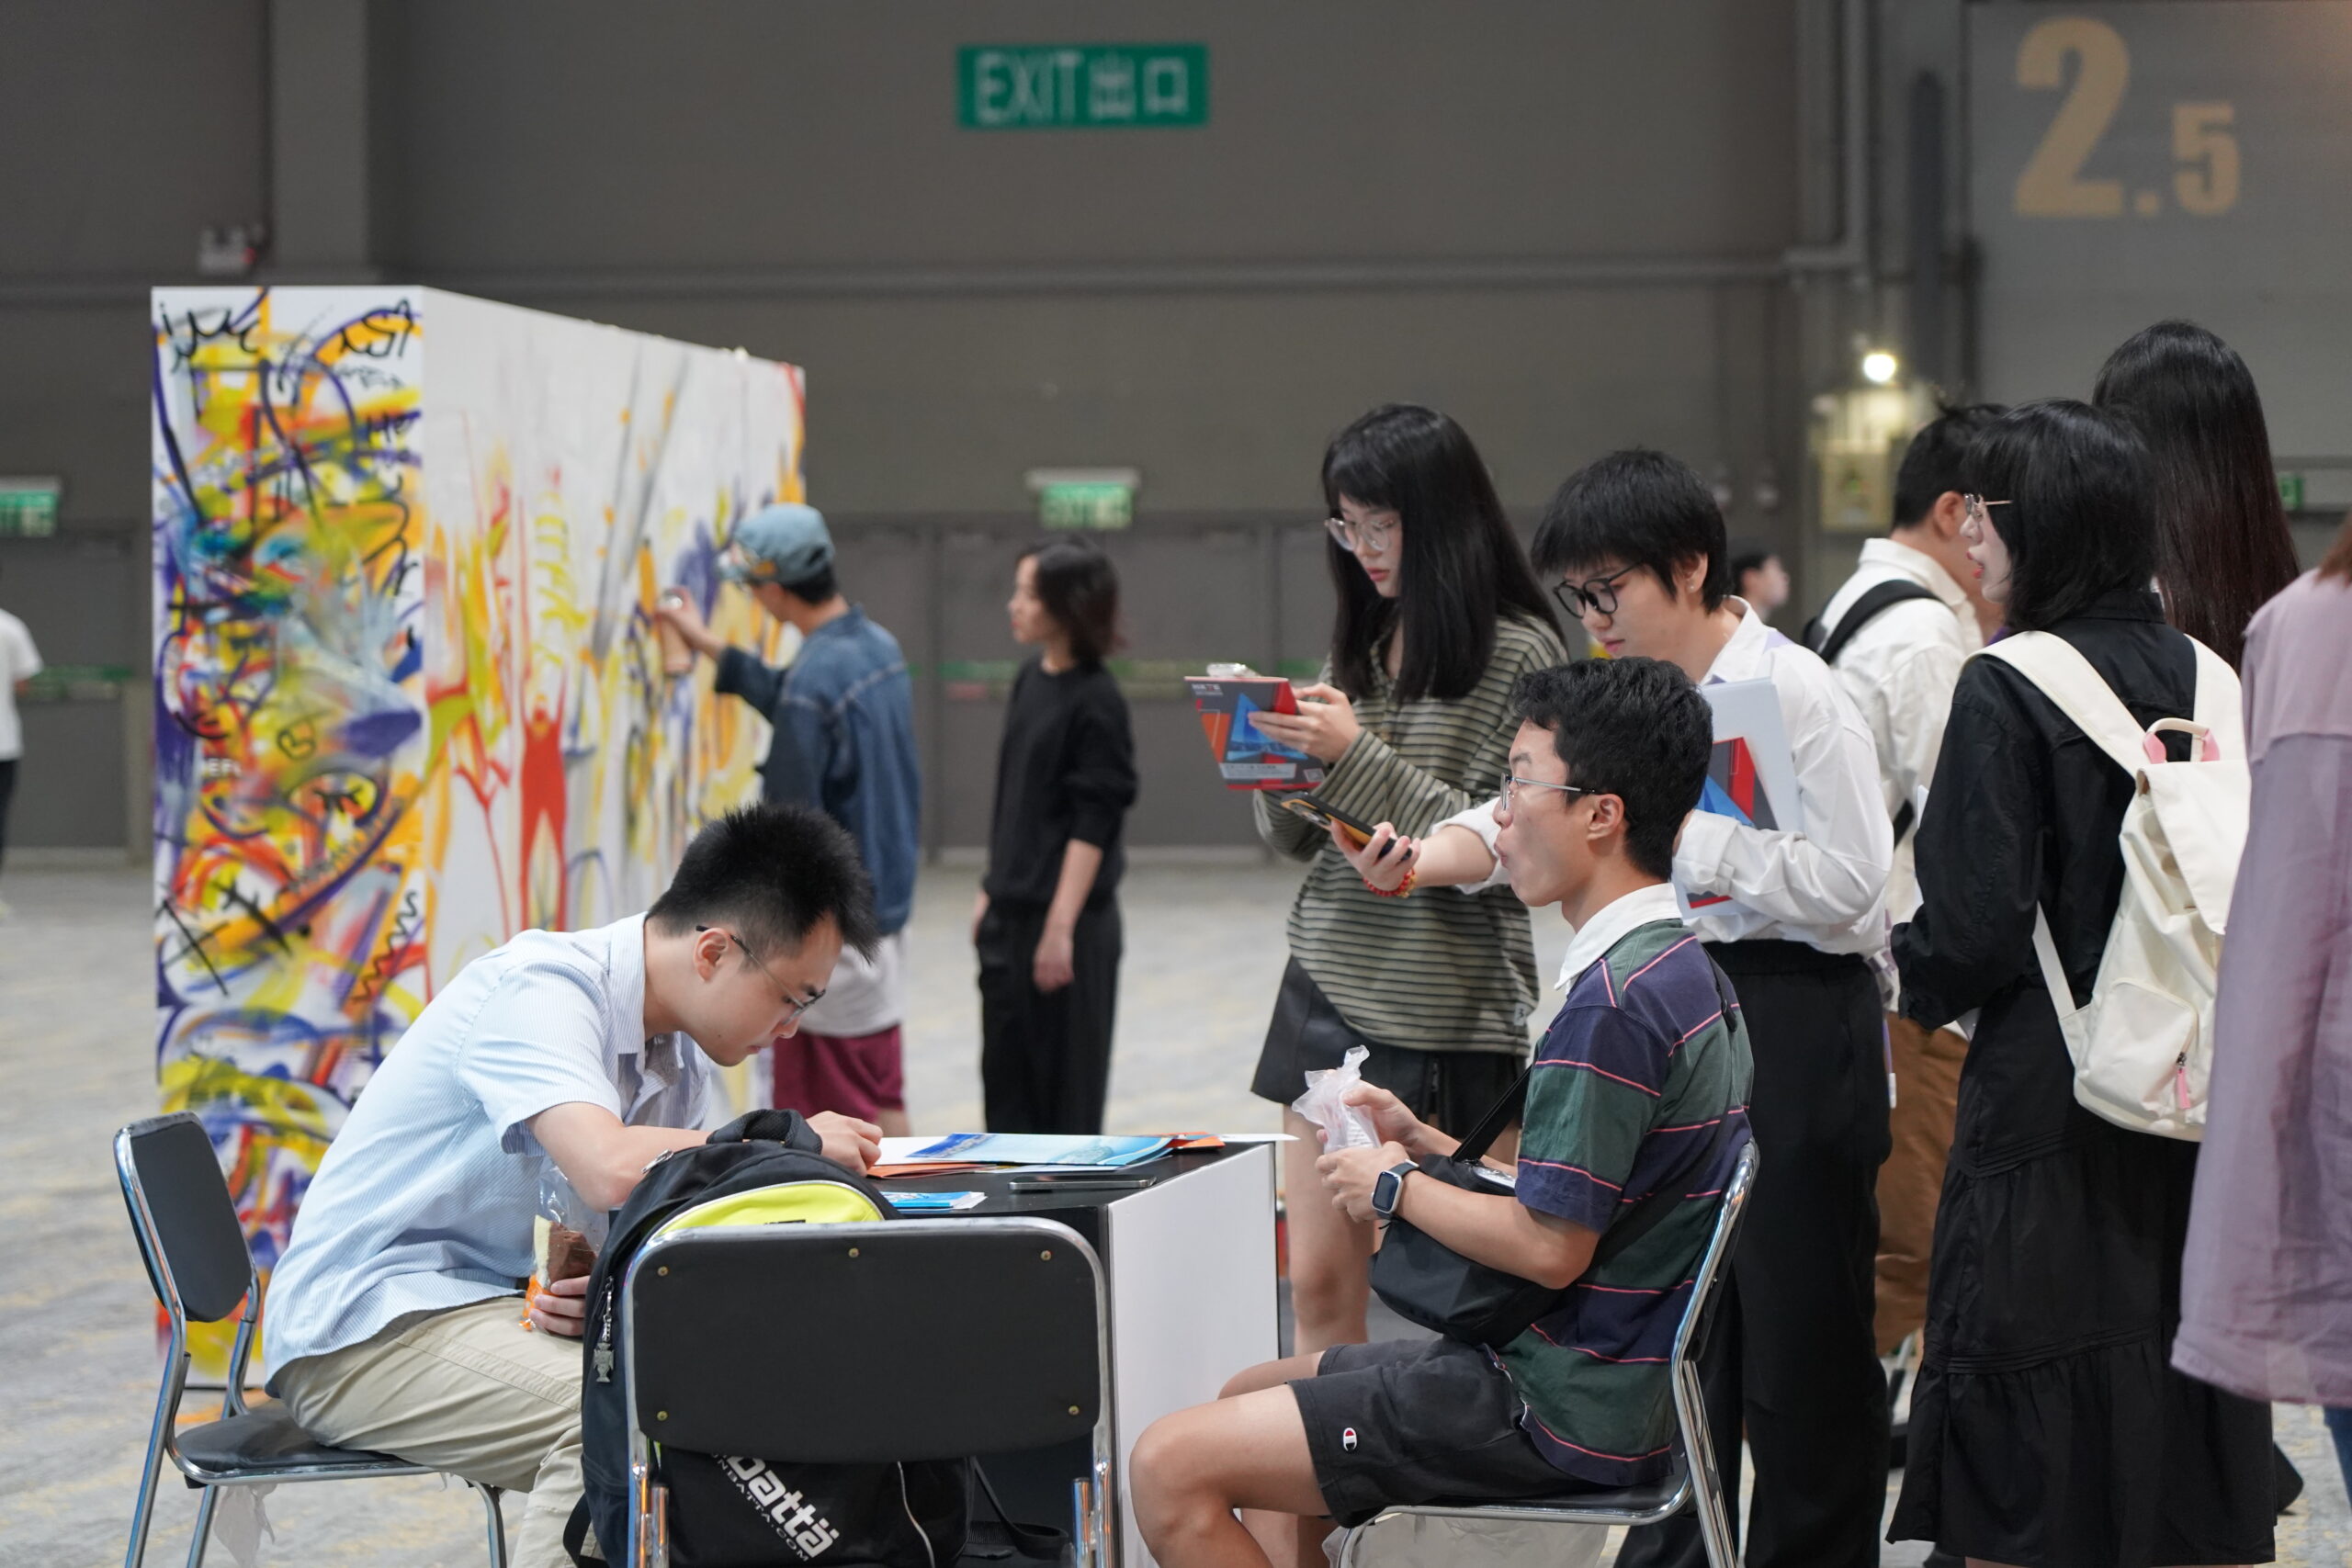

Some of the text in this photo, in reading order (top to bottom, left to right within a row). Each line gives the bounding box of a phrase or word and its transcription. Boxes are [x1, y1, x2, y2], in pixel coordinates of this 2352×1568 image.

[974, 51, 1188, 123] EXIT 出口
[2016, 17, 2240, 217] 2.5
